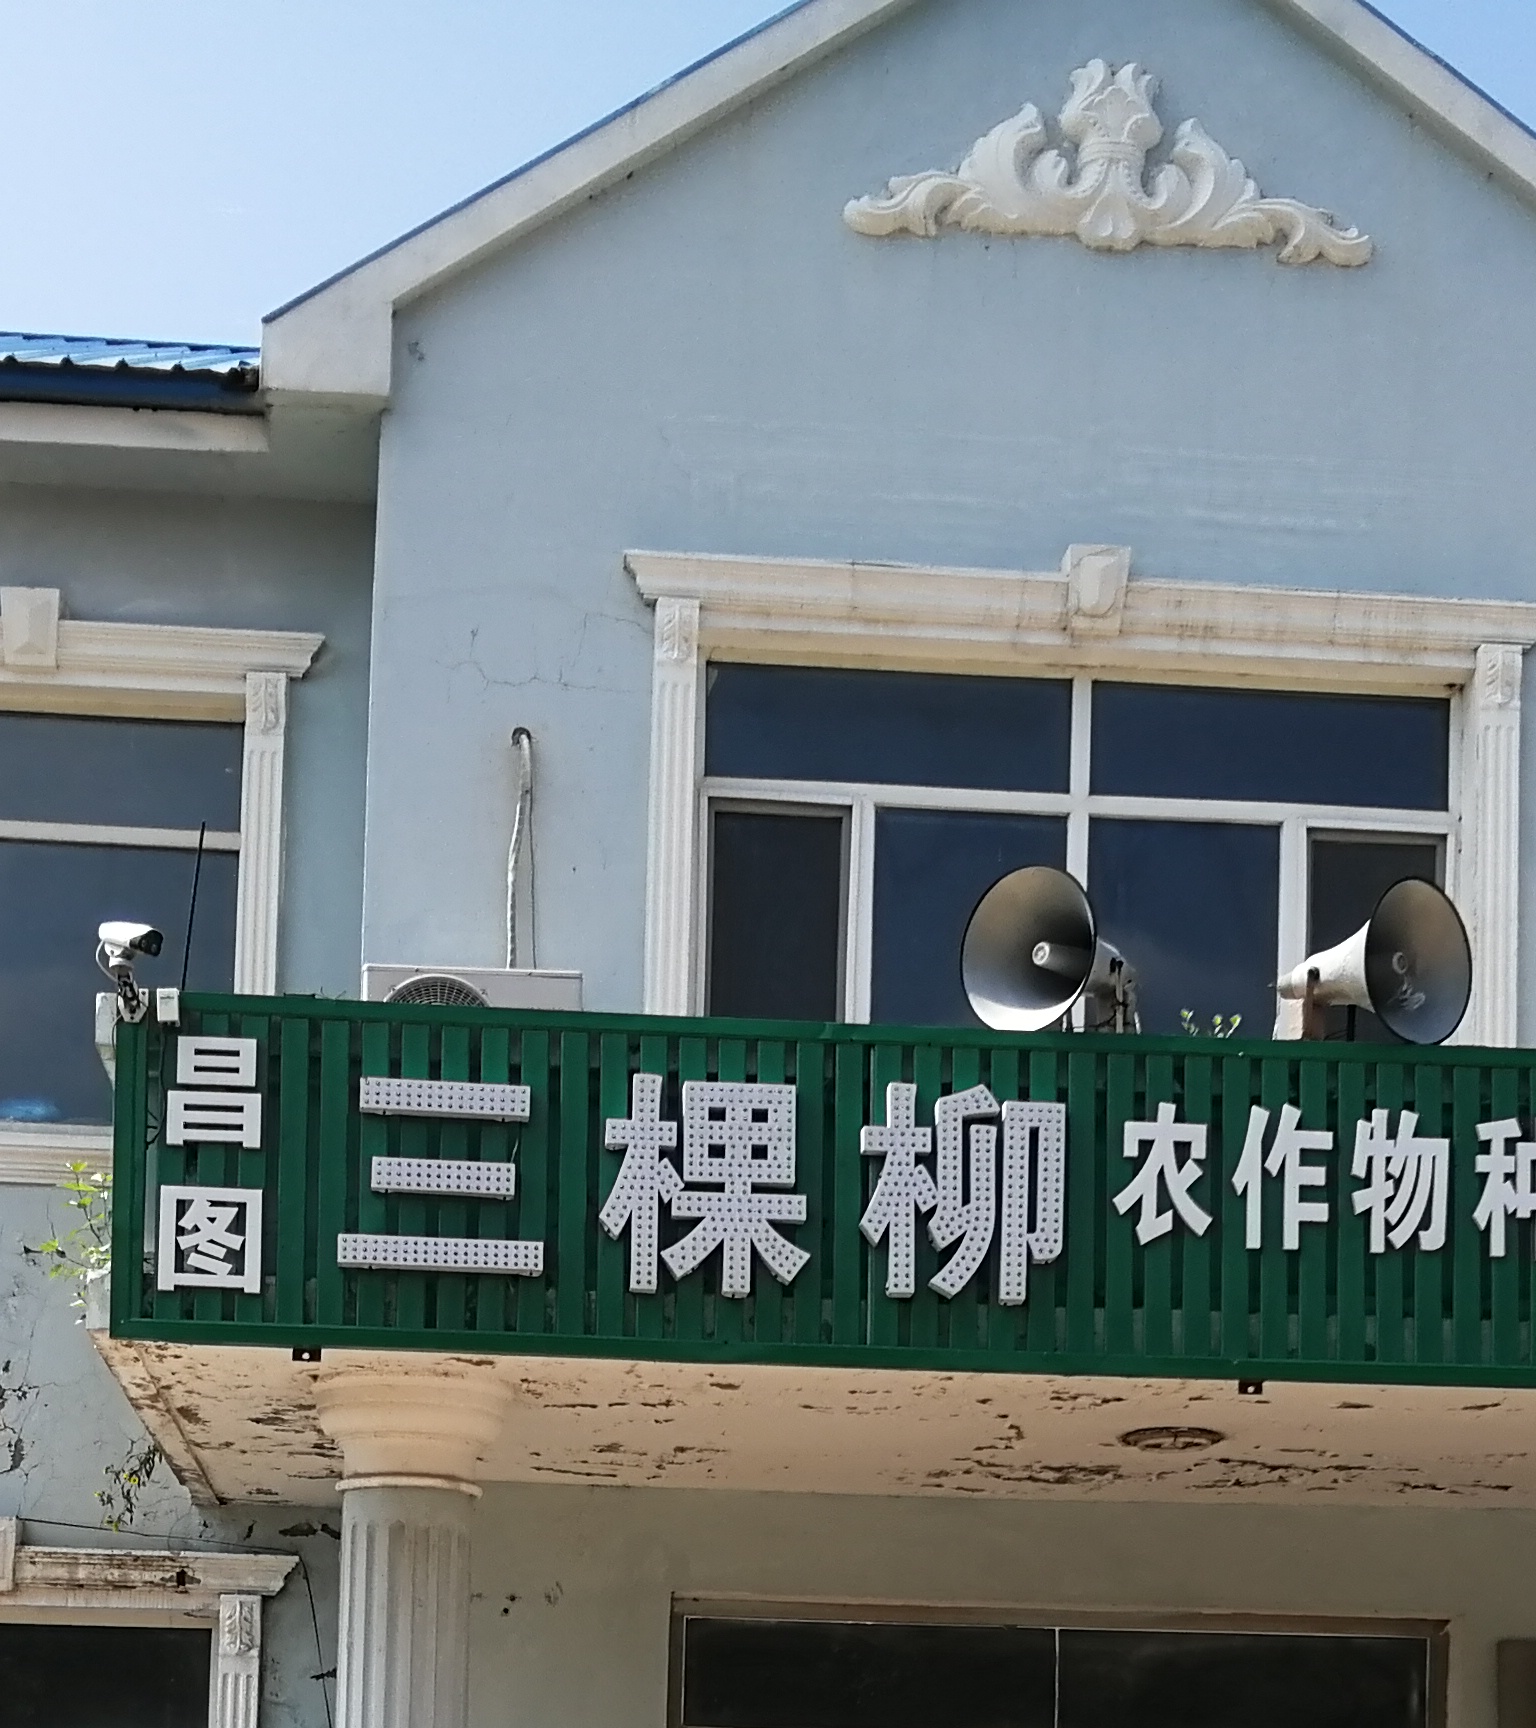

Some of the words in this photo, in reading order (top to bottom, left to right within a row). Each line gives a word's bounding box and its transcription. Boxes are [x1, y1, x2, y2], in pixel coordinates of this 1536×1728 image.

[156, 1035, 263, 1294] 昌图
[336, 1073, 1066, 1306] 三棵柳
